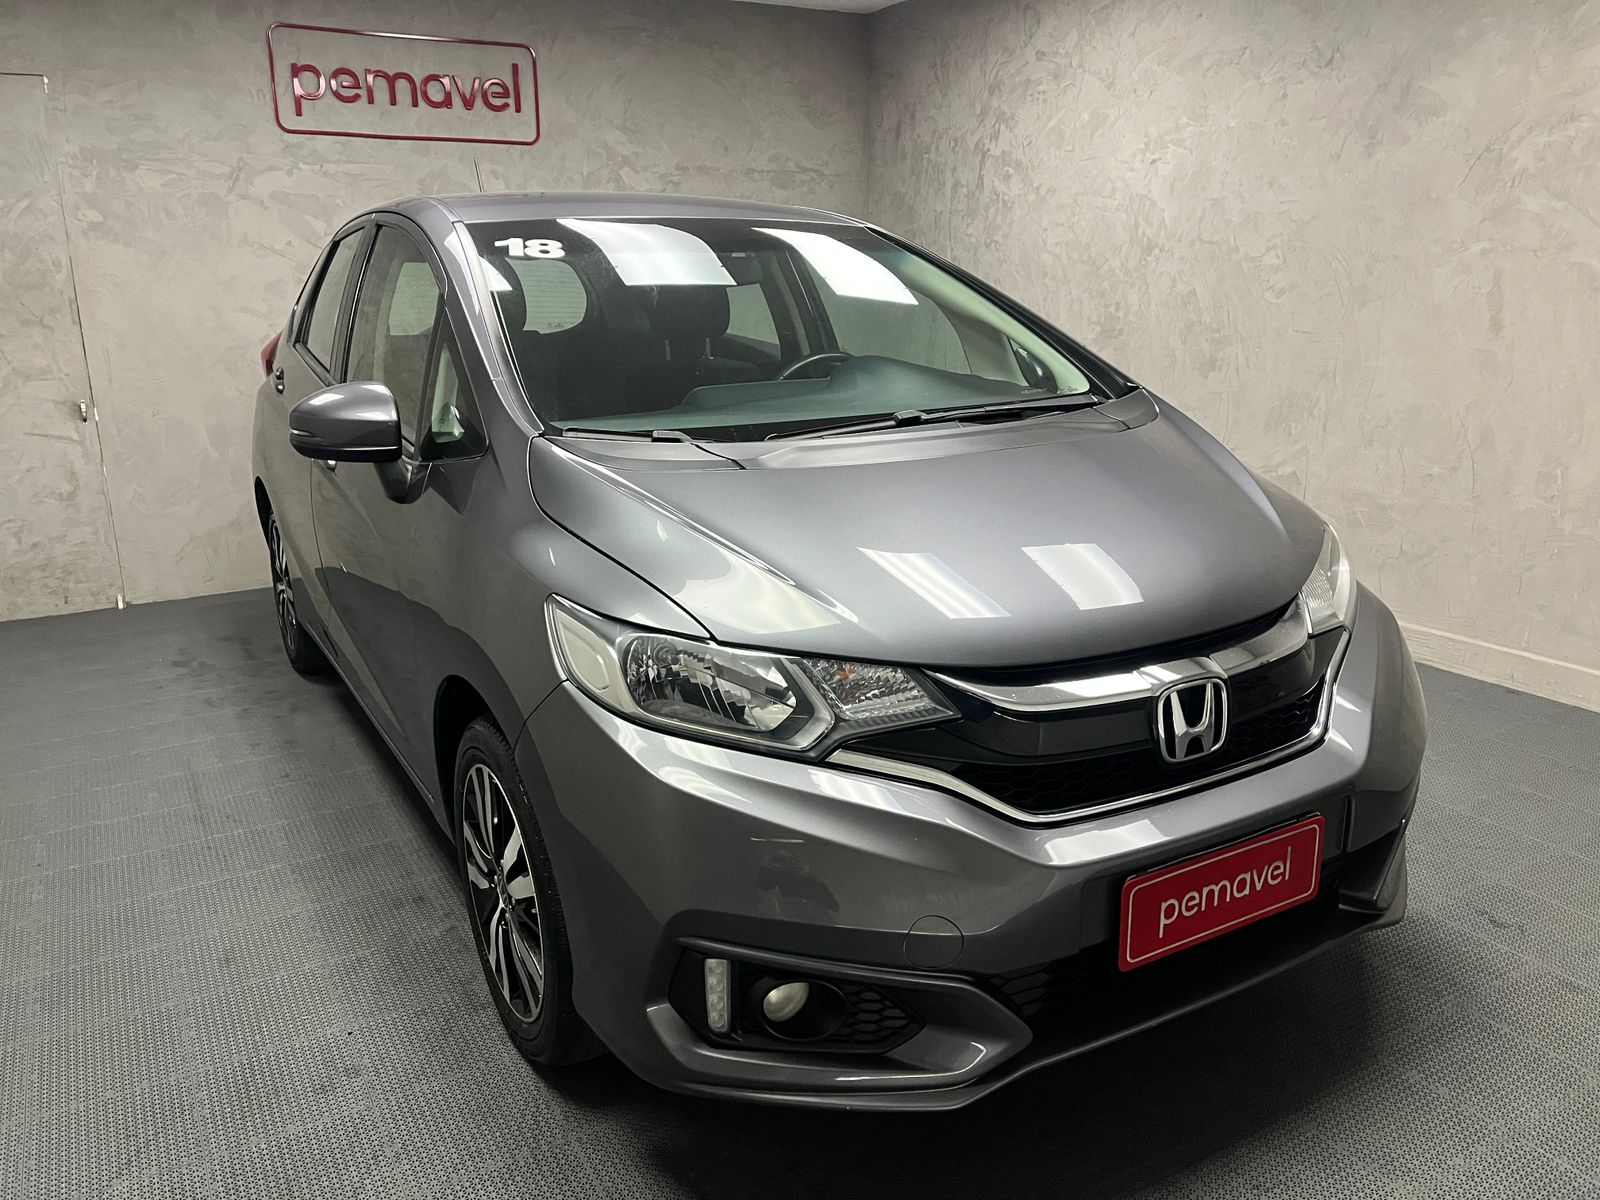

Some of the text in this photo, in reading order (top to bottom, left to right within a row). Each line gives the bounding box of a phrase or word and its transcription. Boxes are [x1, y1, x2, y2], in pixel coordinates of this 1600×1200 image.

[291, 63, 521, 117] pemavel
[494, 237, 566, 259] 18
[1158, 846, 1292, 939] pemavel
